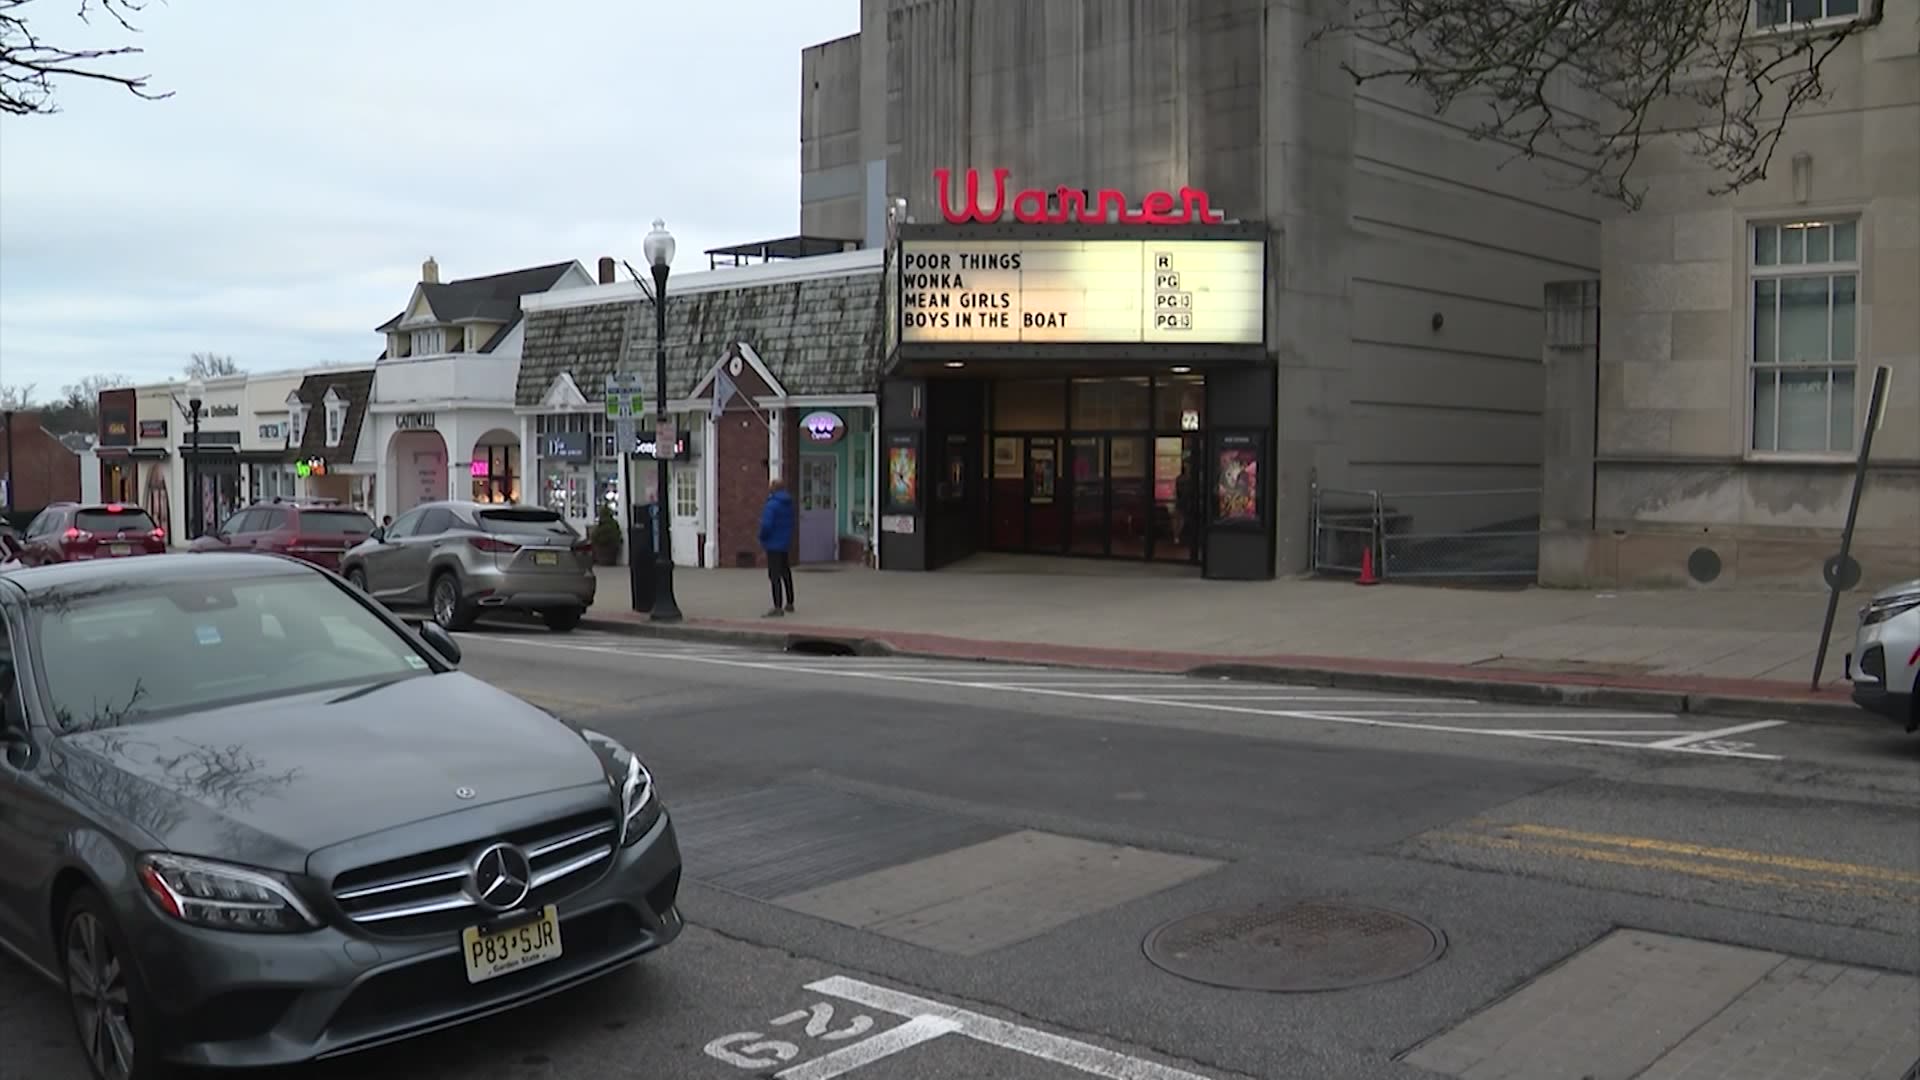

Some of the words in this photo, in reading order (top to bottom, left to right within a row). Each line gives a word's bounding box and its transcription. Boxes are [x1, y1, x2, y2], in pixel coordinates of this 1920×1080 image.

[933, 168, 1222, 224] Warner
[904, 254, 950, 269] POOR
[960, 254, 1021, 269] THINGS
[1158, 256, 1169, 268] R
[903, 274, 963, 288] WONKA
[1157, 275, 1177, 288] PG
[904, 293, 950, 308] MEAN
[960, 293, 1010, 308] GIRLS
[904, 313, 950, 327] BOYS
[955, 313, 972, 327] IN
[979, 313, 1009, 327] THE
[1024, 313, 1067, 327] BOAT
